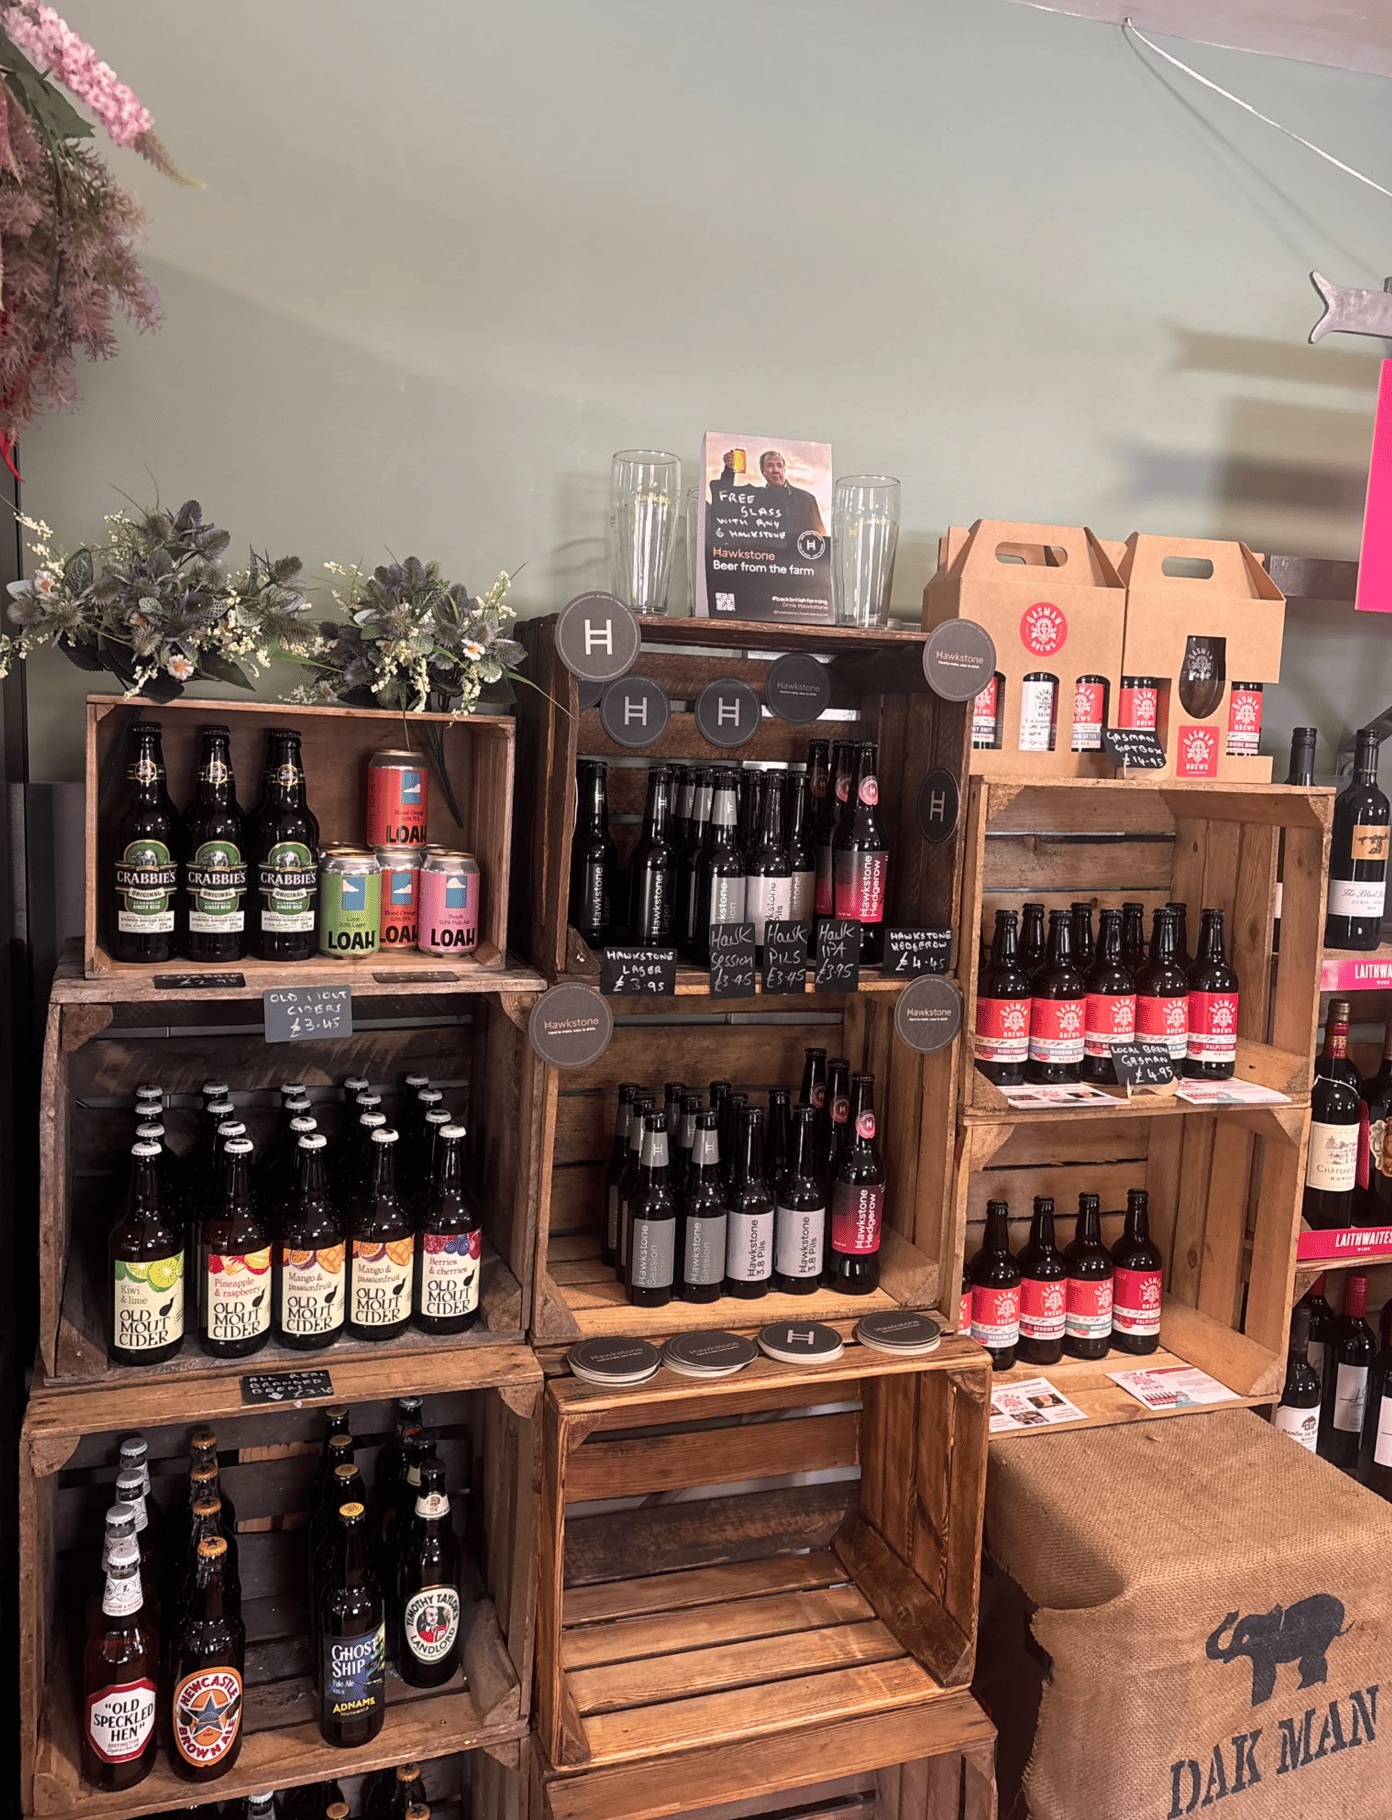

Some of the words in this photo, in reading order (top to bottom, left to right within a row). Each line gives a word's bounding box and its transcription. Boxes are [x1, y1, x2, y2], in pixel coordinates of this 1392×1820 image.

[719, 490, 755, 504] FREE
[716, 517, 748, 526] WITH
[756, 519, 780, 529] ANY
[715, 527, 724, 538] 6
[729, 530, 786, 539] HAWKSTONE
[713, 547, 775, 561] Hawkstone
[713, 560, 738, 571] Beer
[741, 562, 767, 573] from
[769, 564, 787, 574] the
[789, 565, 814, 575] farm
[1026, 607, 1062, 624] GASMAN
[1031, 641, 1056, 651] BREWS
[936, 650, 984, 664] Hawkstone
[777, 681, 820, 692] Hawkstone
[1107, 731, 1155, 743] GASMAN
[1183, 730, 1214, 745] GASMAN
[1186, 763, 1209, 771] BREWS
[386, 825, 427, 843] LOAH
[117, 869, 176, 885] CRABBIE'S
[188, 871, 246, 886] CRABBIE'S
[260, 871, 316, 886] CRABBIE'S
[860, 855, 873, 917] Hawkstone
[869, 860, 881, 917] Hedgerow
[131, 890, 162, 898] ORIGINAL
[203, 890, 233, 898] ORIGINAL
[592, 866, 603, 926] Hawkstone
[651, 874, 663, 935] Hawkstone
[380, 925, 418, 943] OAH
[431, 928, 475, 946] LOAH
[711, 925, 753, 950] Hawk
[767, 922, 807, 944] Hawk
[820, 922, 855, 940] Hawk
[890, 930, 951, 940] HAWKSTONE
[328, 930, 375, 950] LOAH
[891, 941, 947, 952] HEDGEROW
[607, 951, 674, 961] HAWKSTONE
[770, 947, 800, 965] PILS
[822, 942, 847, 958] IPA
[622, 965, 662, 977] LAGER
[270, 992, 298, 1002] OLD
[287, 1003, 341, 1015] CIDERS
[907, 1008, 952, 1017] Hawkstone
[290, 1017, 340, 1038] £3.45
[544, 1018, 600, 1030] Hawkstone
[1111, 1046, 1139, 1054] LOCAL
[1121, 1055, 1168, 1066] GASMAN
[854, 1189, 868, 1249] Hawkstone
[865, 1194, 876, 1248] Hedgerow
[690, 1222, 701, 1282] Hawkstone
[747, 1219, 758, 1276] Hawkstone
[757, 1240, 765, 1258] Pils
[798, 1216, 810, 1273] Hawkstone
[809, 1237, 817, 1254] Pils
[429, 1257, 457, 1266] Berries
[637, 1224, 648, 1285] Hawkstone
[700, 1242, 711, 1282] Session
[358, 1264, 384, 1275] Mango
[385, 1265, 391, 1273] &
[437, 1266, 467, 1275] cherries
[647, 1244, 658, 1286] Session
[756, 1260, 765, 1275] 3.8
[807, 1257, 816, 1272] 3.8
[214, 1277, 255, 1289] Pineapple
[288, 1272, 314, 1282] Mango
[316, 1273, 323, 1281] &
[357, 1273, 400, 1283] passionfruit
[120, 1284, 140, 1295] Kiwi
[214, 1289, 221, 1297] &
[223, 1285, 261, 1299] raspberry
[288, 1282, 332, 1292] passionfruit
[427, 1280, 457, 1291] OLD
[128, 1296, 147, 1304] lime
[356, 1288, 385, 1299] OLD
[428, 1287, 471, 1302] MOUT
[213, 1302, 245, 1314] OLD
[287, 1296, 317, 1308] OLD
[357, 1295, 402, 1310] MOUT
[426, 1299, 470, 1315] CIDER
[119, 1309, 151, 1322] OLD
[214, 1307, 262, 1325] MOUT
[288, 1304, 334, 1320] MOUT
[355, 1308, 400, 1323] CIDER
[120, 1316, 170, 1333] MOUT
[213, 1320, 261, 1338] CIDER
[286, 1317, 332, 1332] CIDER
[873, 1320, 920, 1332] Hawkstone
[119, 1330, 168, 1346] CIDER
[590, 1347, 644, 1361] Hawkstone
[689, 1341, 740, 1355] Hawkstone
[407, 1595, 434, 1626] TIMOTHY
[410, 1627, 455, 1655] LANDLORD
[332, 1636, 378, 1662] GHOST
[332, 1659, 365, 1678] SHIP
[180, 1675, 238, 1707] NEWCASTLE
[332, 1679, 344, 1688] Pale
[345, 1680, 354, 1688] Ale
[332, 1697, 375, 1714] ADNAMS
[93, 1703, 153, 1729] SPECKLED
[107, 1739, 139, 1748] DISTINCTIVE
[179, 1727, 221, 1759] BROWN
[222, 1718, 236, 1745] ALE
[1167, 1727, 1263, 1820] DAK
[1276, 1684, 1379, 1775] MAN
